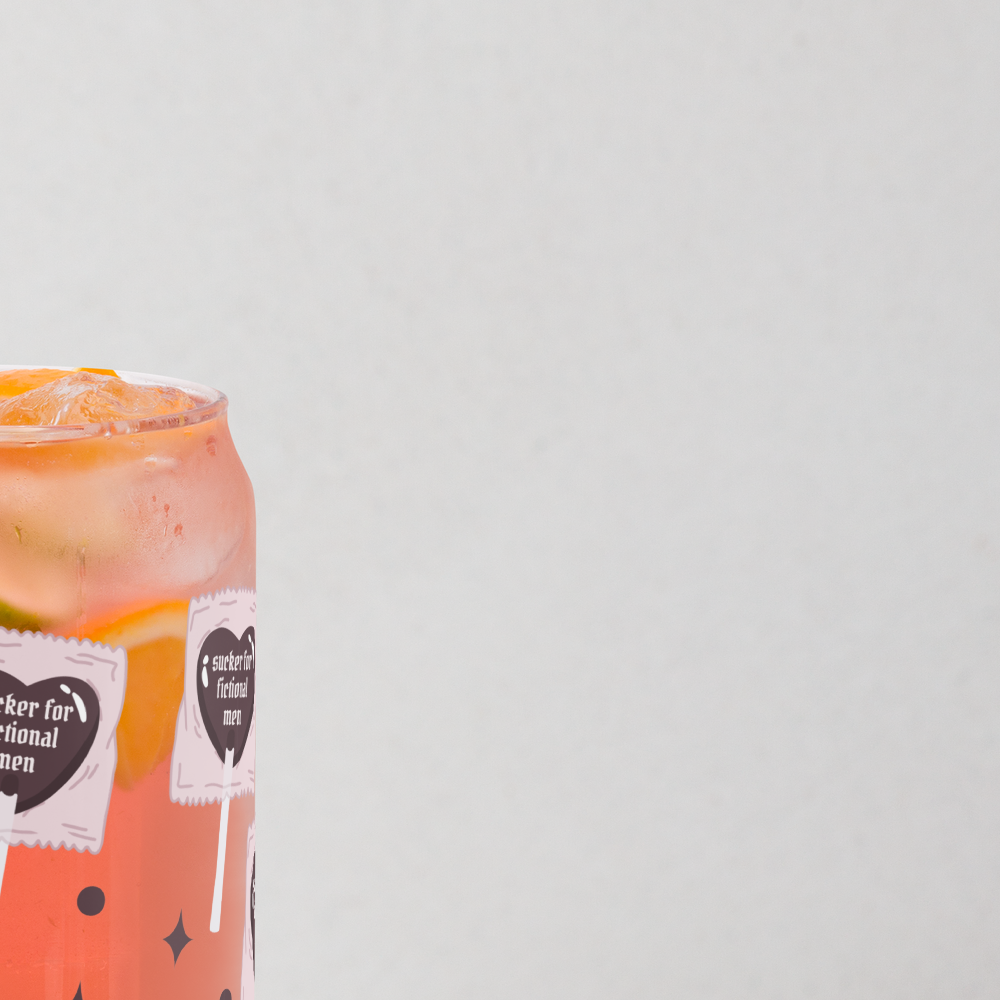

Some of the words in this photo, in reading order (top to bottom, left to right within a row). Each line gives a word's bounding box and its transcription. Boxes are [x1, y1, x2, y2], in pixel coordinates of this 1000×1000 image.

[212, 650, 243, 672] sucker
[216, 676, 249, 699] fictional
[44, 698, 74, 722] for
[223, 709, 242, 726] men
